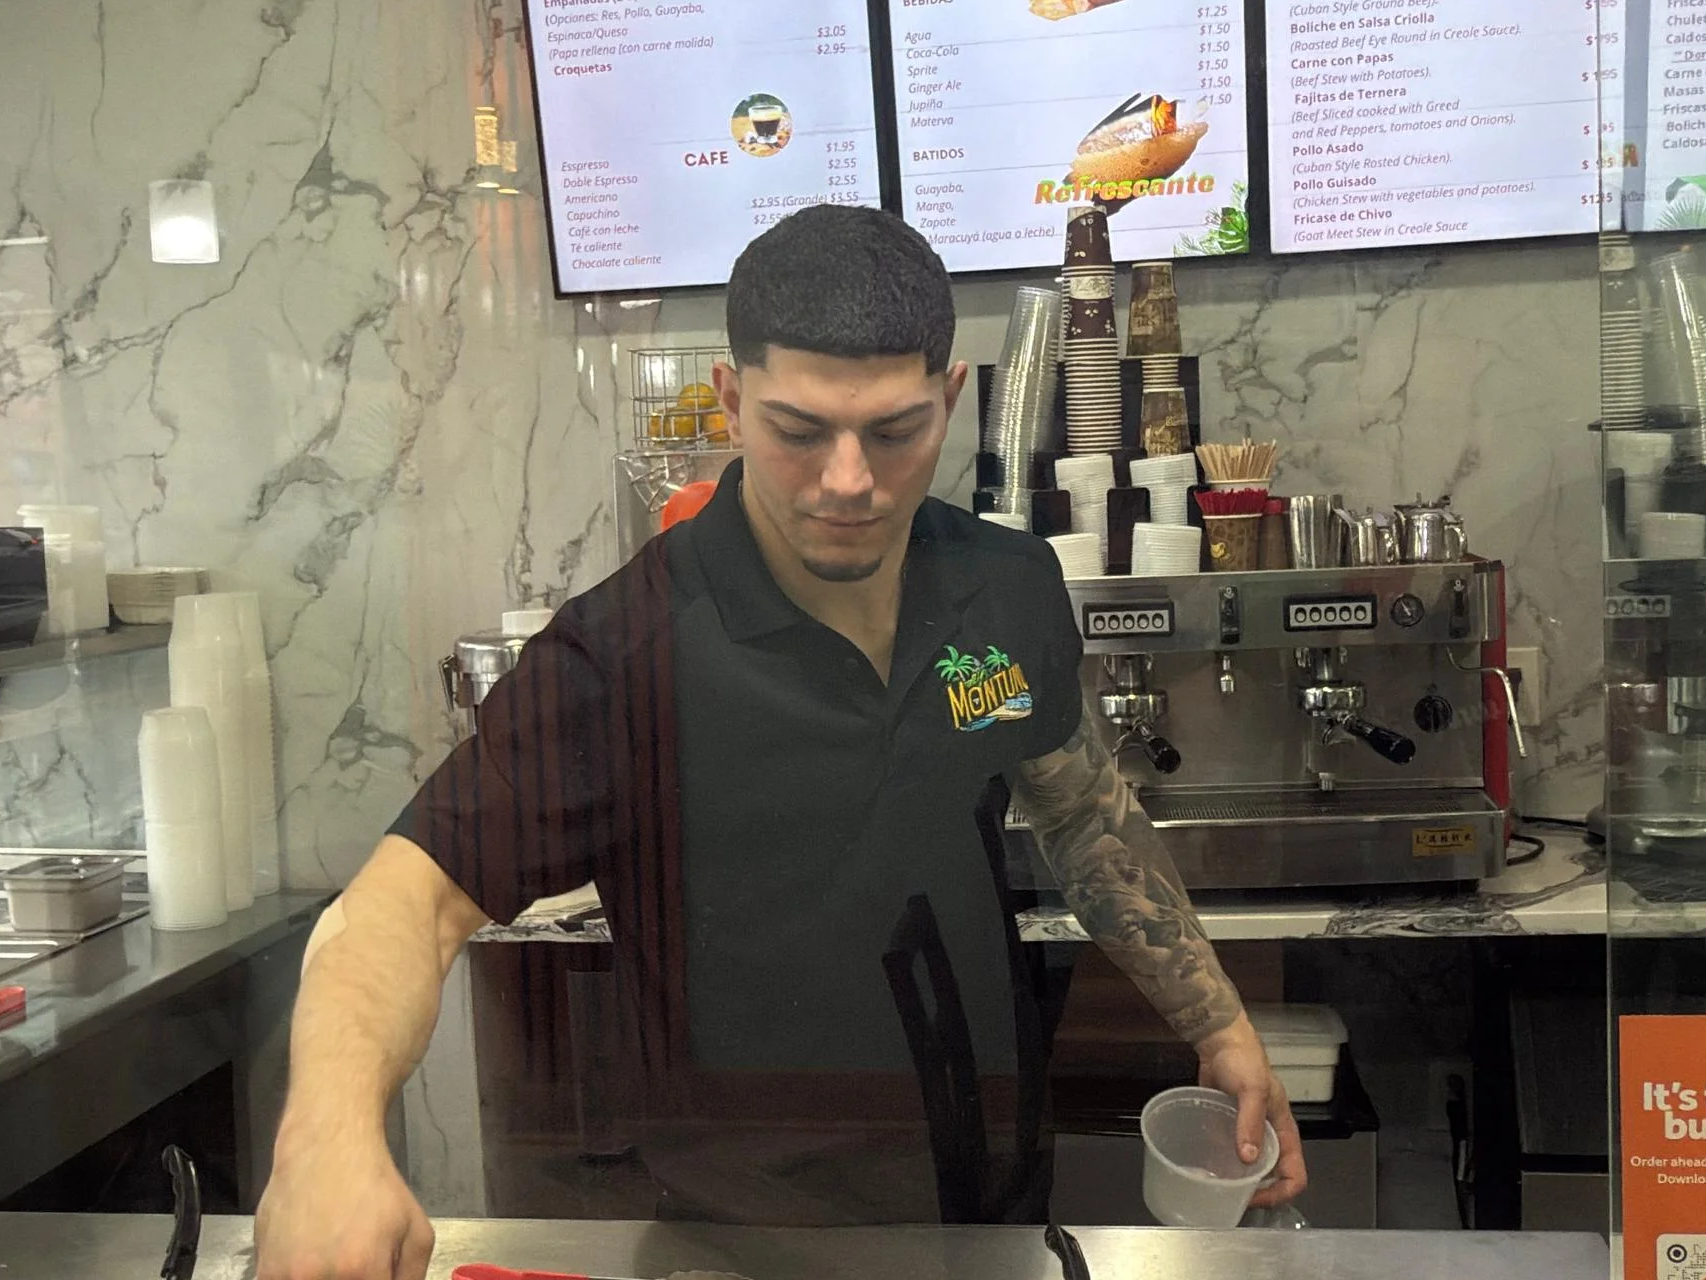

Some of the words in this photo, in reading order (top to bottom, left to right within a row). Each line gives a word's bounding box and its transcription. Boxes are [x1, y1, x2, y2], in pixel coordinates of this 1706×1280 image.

[904, 32, 931, 44] Agua
[906, 44, 959, 59] Coca-Cola
[1291, 58, 1327, 69] Carne
[1330, 56, 1352, 66] con
[1357, 53, 1393, 66] Papas
[554, 63, 612, 77] Croquetas
[907, 65, 937, 78] Sprite
[908, 82, 943, 95] Ginger
[945, 79, 961, 90] Ale
[913, 148, 964, 161] BATIDOS
[1293, 145, 1323, 156] Pollo
[1326, 142, 1363, 154] Asado
[684, 151, 728, 166] CAFE
[561, 161, 609, 173] Esspresso
[563, 176, 592, 188] Doble
[594, 175, 637, 188] Espresso
[1033, 171, 1216, 205] Refrescante
[1293, 179, 1323, 190] Pollo
[1327, 175, 1376, 188] Guisado
[564, 192, 618, 204] Americano
[916, 201, 953, 213] Mango,
[566, 208, 620, 223] Capuchino
[1294, 213, 1336, 224] Fricase
[1340, 210, 1354, 221] de
[1358, 208, 1392, 220] Chivo
[568, 225, 590, 239] Café
[592, 227, 611, 235] con
[613, 224, 639, 234] leche
[571, 258, 620, 269] Chocolate
[623, 255, 661, 266] caliente
[1643, 1082, 1698, 1111] It's
[1631, 1156, 1667, 1168] Order
